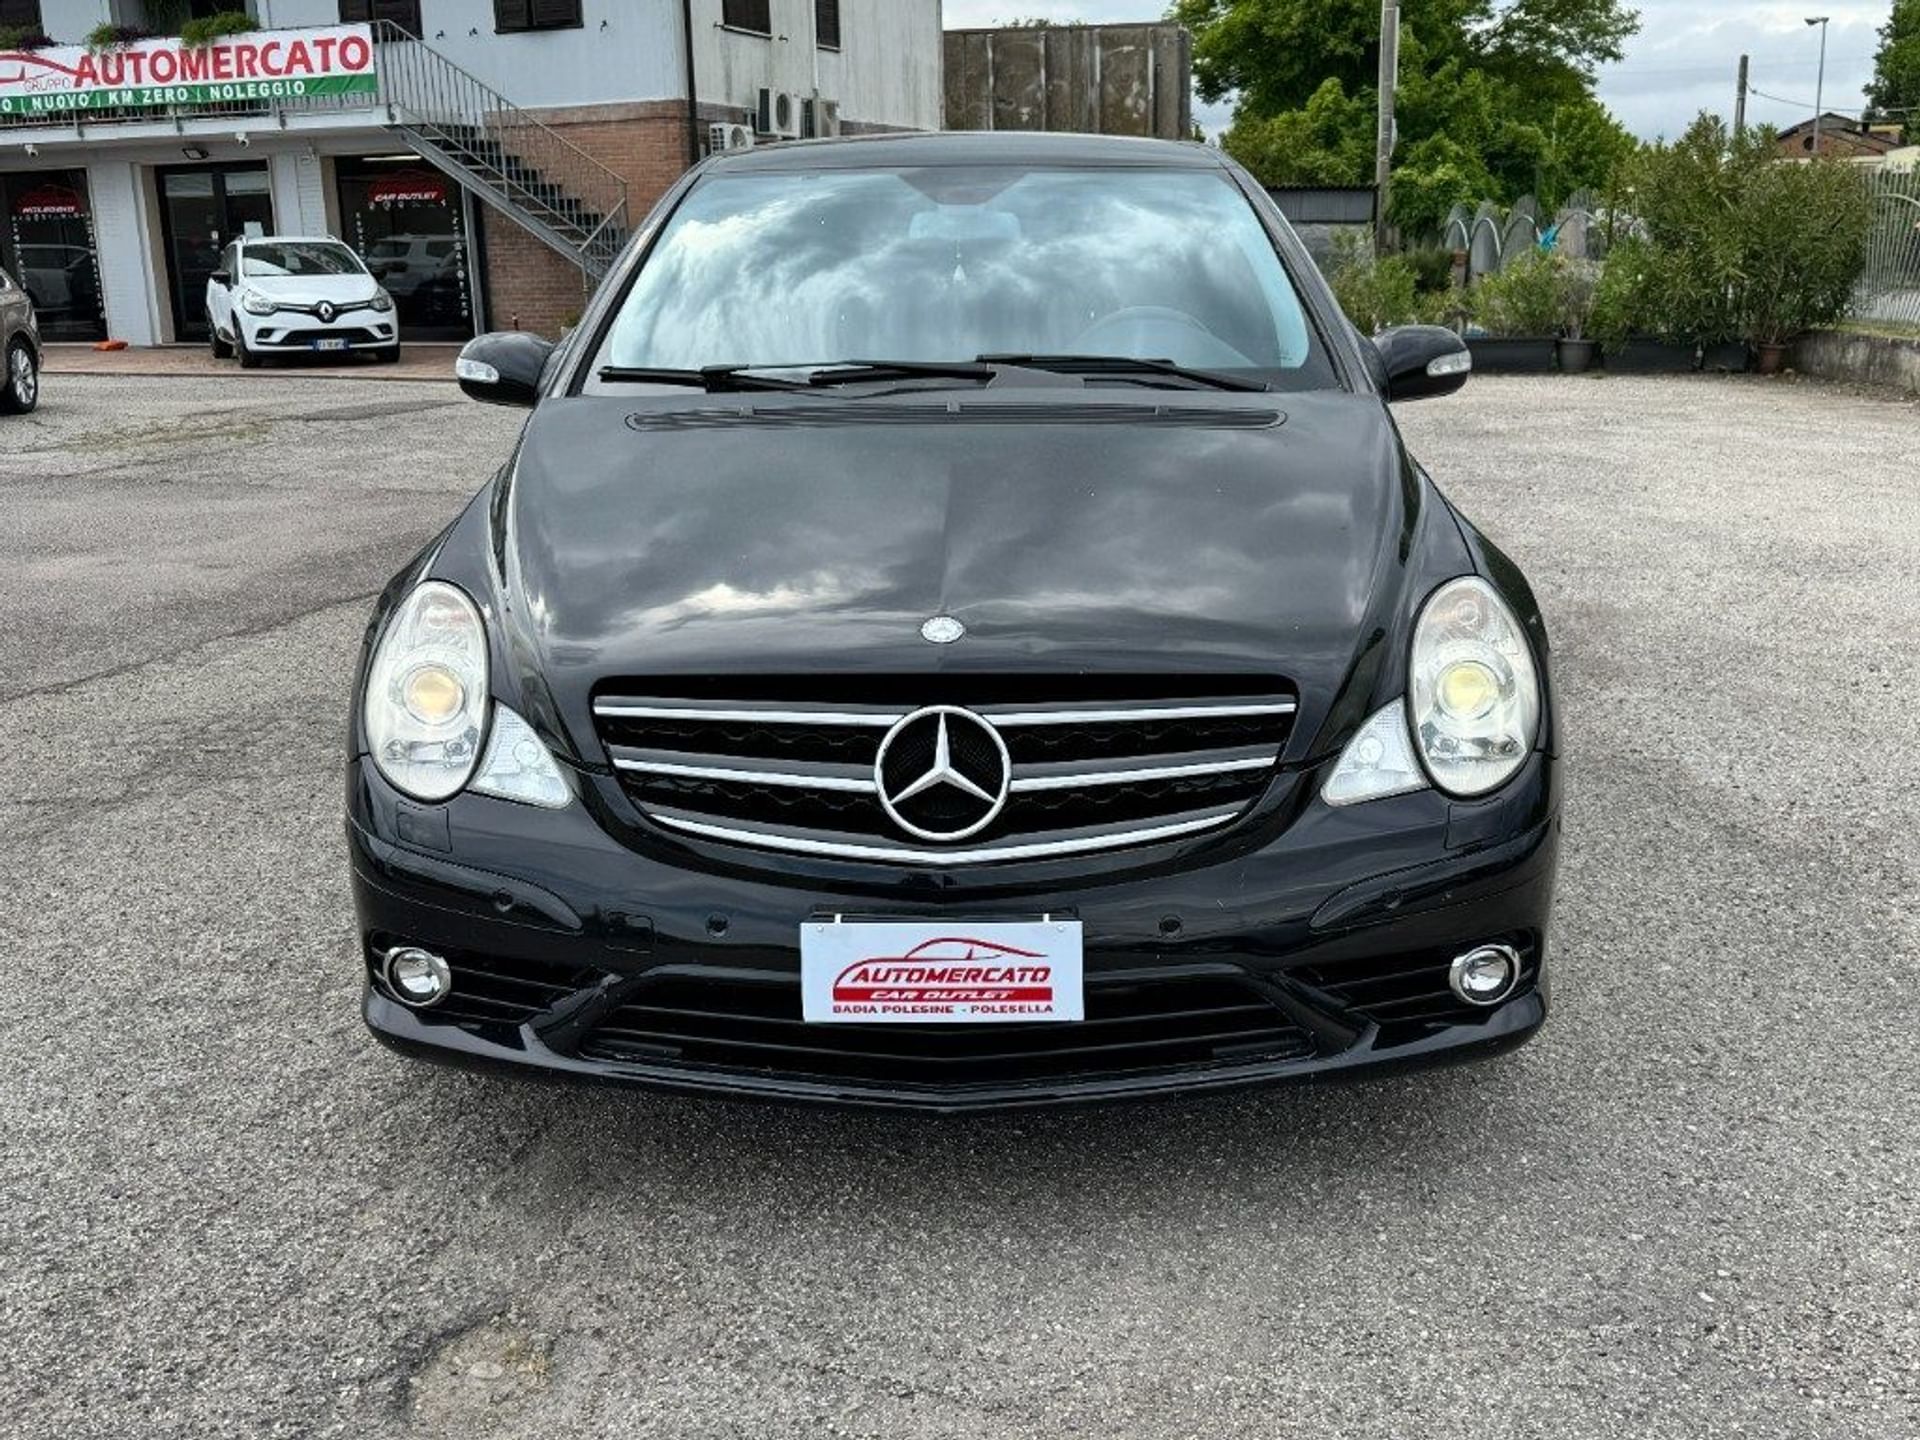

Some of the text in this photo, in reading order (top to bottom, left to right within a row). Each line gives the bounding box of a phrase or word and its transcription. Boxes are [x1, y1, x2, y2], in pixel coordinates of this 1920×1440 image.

[74, 35, 369, 88] AUTOMERCATO
[24, 77, 71, 93] GRUPPO
[31, 93, 88, 112] NUOVO
[108, 89, 134, 105] KM
[143, 87, 188, 103] ZERO
[209, 80, 305, 100] NOLEGGIO
[851, 967, 1051, 983] AUTOMERCATO
[870, 990, 1015, 999] CAR OUTLET
[833, 1005, 878, 1014] BADIA
[882, 1005, 954, 1014] POLESINE
[971, 1005, 1053, 1014] POLESELLA
